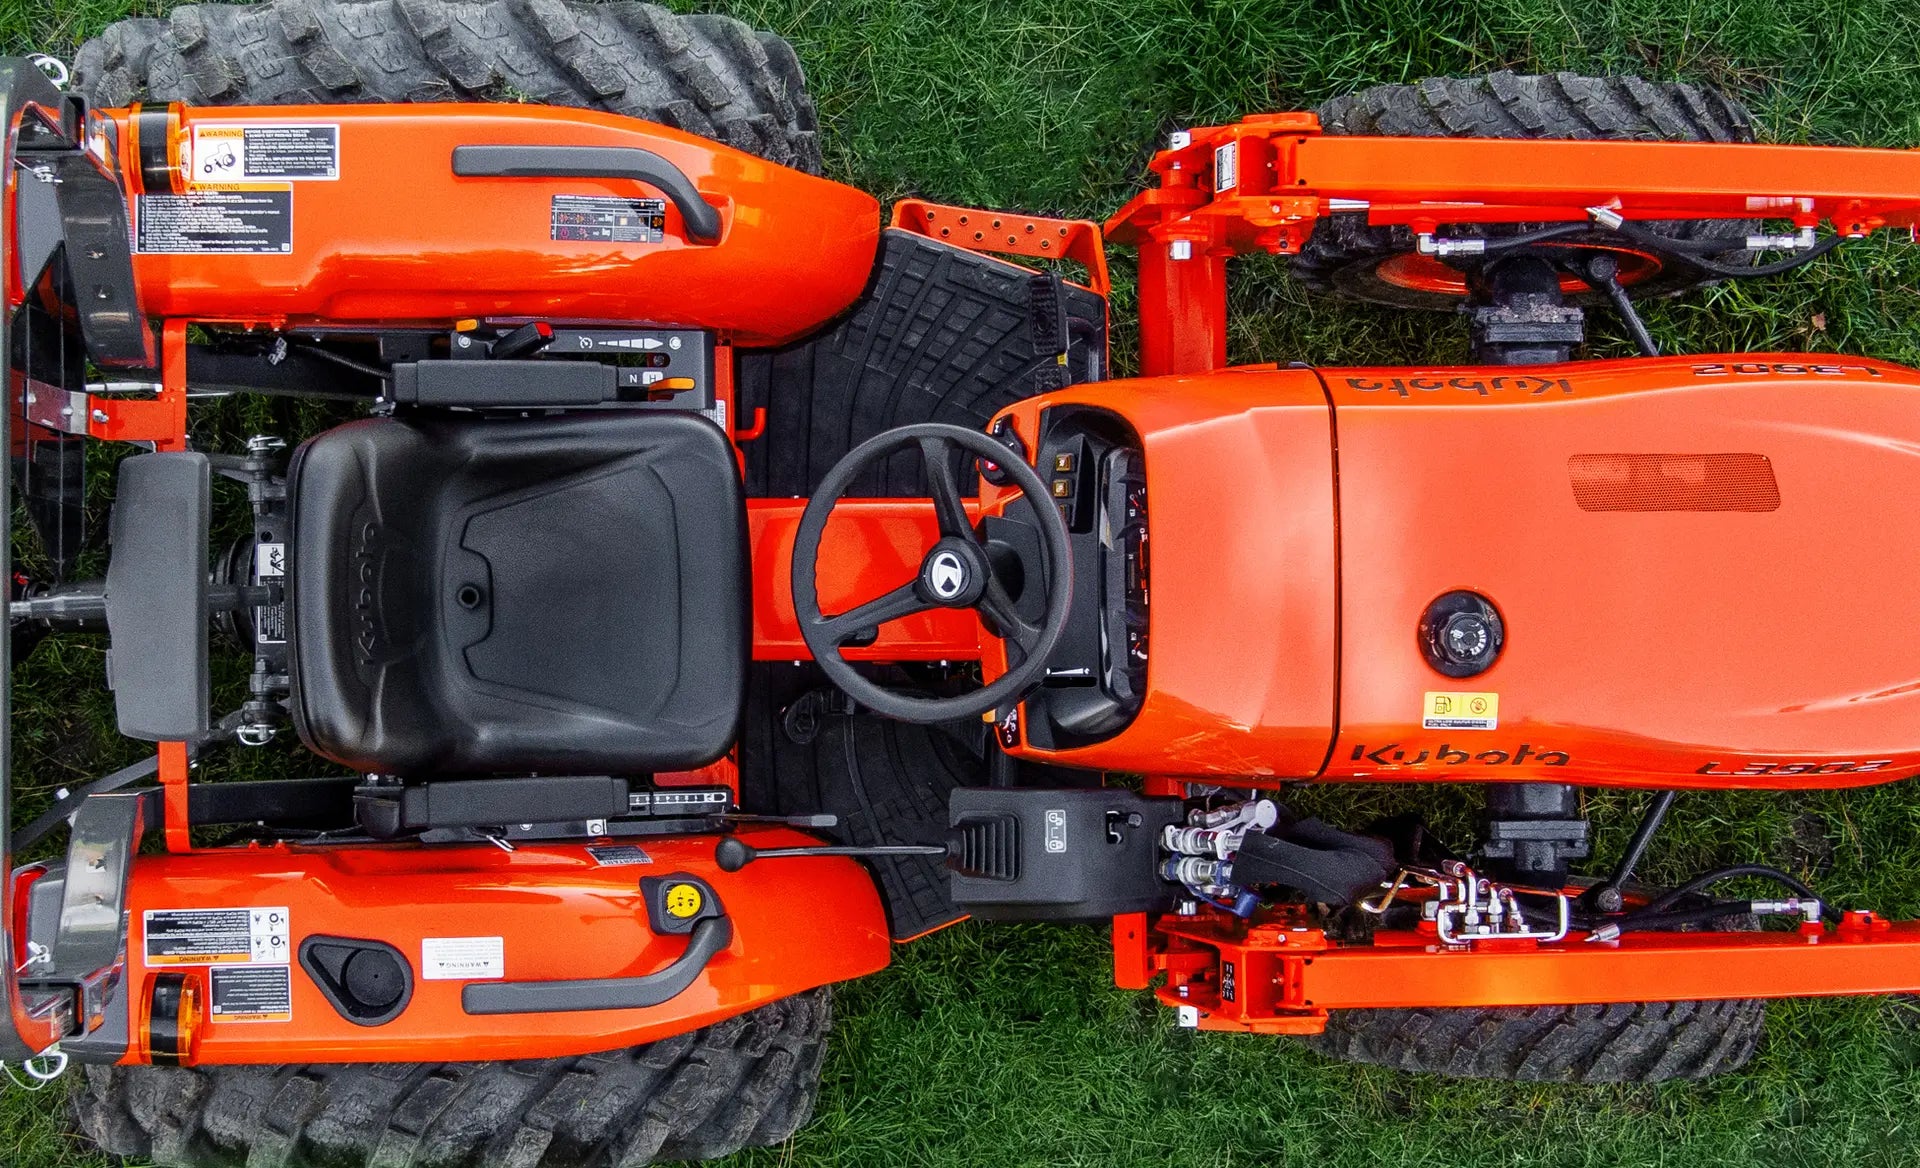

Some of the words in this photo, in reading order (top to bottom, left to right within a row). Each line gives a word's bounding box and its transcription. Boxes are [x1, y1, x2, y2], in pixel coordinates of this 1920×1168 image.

[200, 183, 240, 191] WARNING
[629, 374, 638, 383] N
[1693, 363, 1883, 377] L3902
[1345, 376, 1573, 397] Kubota
[355, 522, 376, 665] Kubota
[1350, 743, 1571, 766] Kubota
[1696, 759, 1893, 776] L3902
